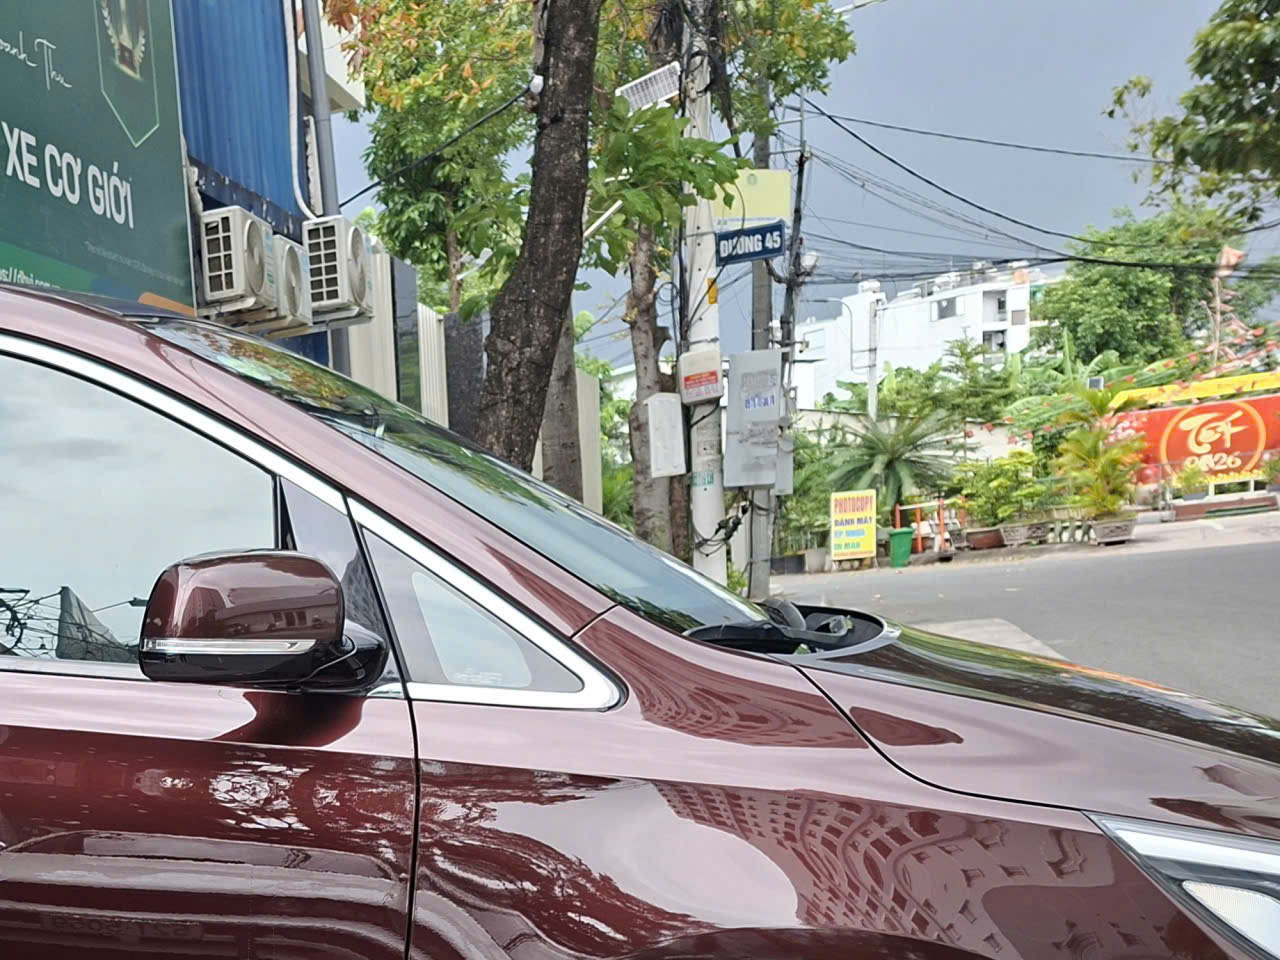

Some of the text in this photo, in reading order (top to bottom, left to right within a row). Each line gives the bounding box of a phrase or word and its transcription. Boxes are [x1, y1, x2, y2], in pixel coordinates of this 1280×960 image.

[1, 121, 40, 189] XE
[45, 144, 81, 204] CƠ
[88, 161, 134, 229] GIỚI
[764, 231, 781, 249] 45
